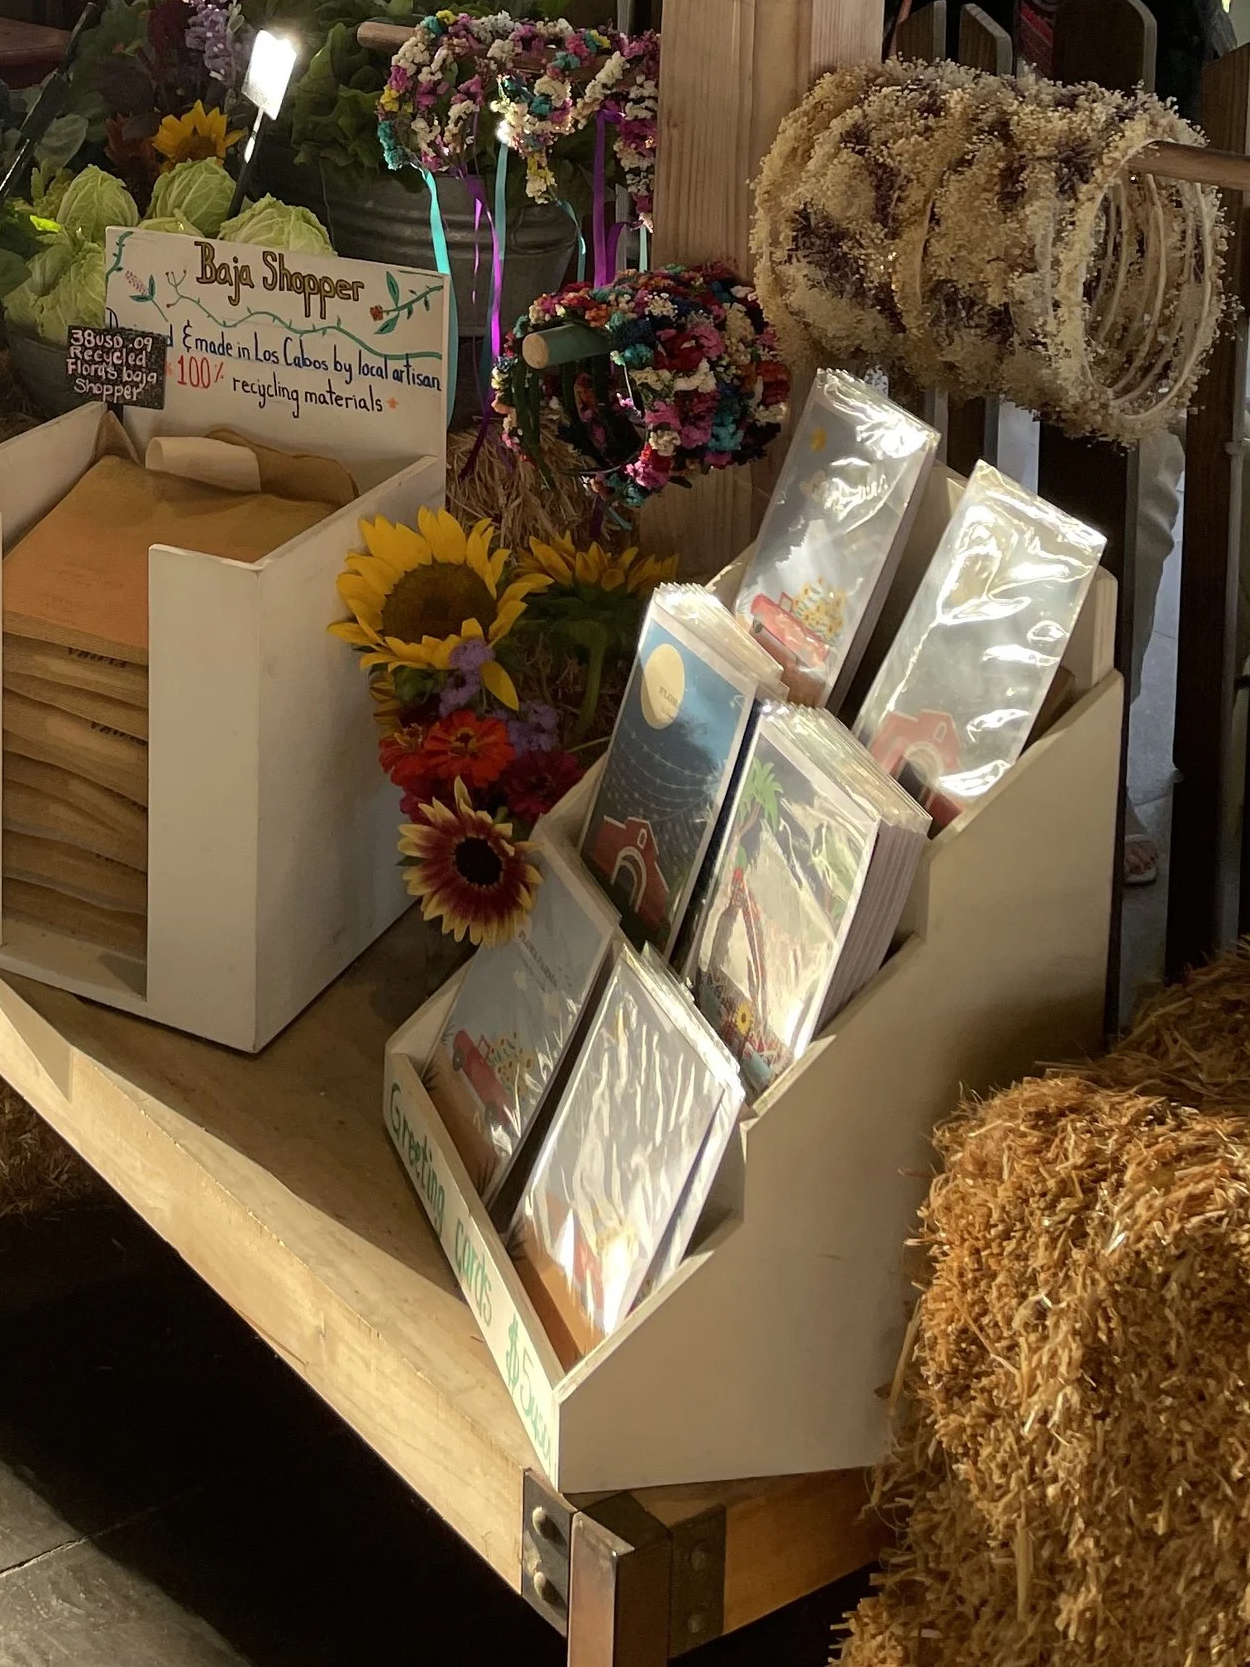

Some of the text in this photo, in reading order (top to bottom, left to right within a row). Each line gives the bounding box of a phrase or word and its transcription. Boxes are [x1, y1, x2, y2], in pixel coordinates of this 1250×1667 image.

[194, 240, 365, 320] Baja Shopper
[69, 345, 147, 368] Recycled
[122, 366, 157, 389] baja
[194, 330, 233, 358] made
[236, 341, 251, 361] in
[254, 330, 280, 365] Los
[283, 337, 329, 371] Cabos
[333, 344, 353, 385] by
[358, 349, 389, 380] local
[392, 352, 442, 392] artisan
[73, 377, 144, 404] Shopper
[233, 371, 383, 419] recycling materials
[390, 1081, 447, 1241] Greeting
[454, 1217, 493, 1328] cards
